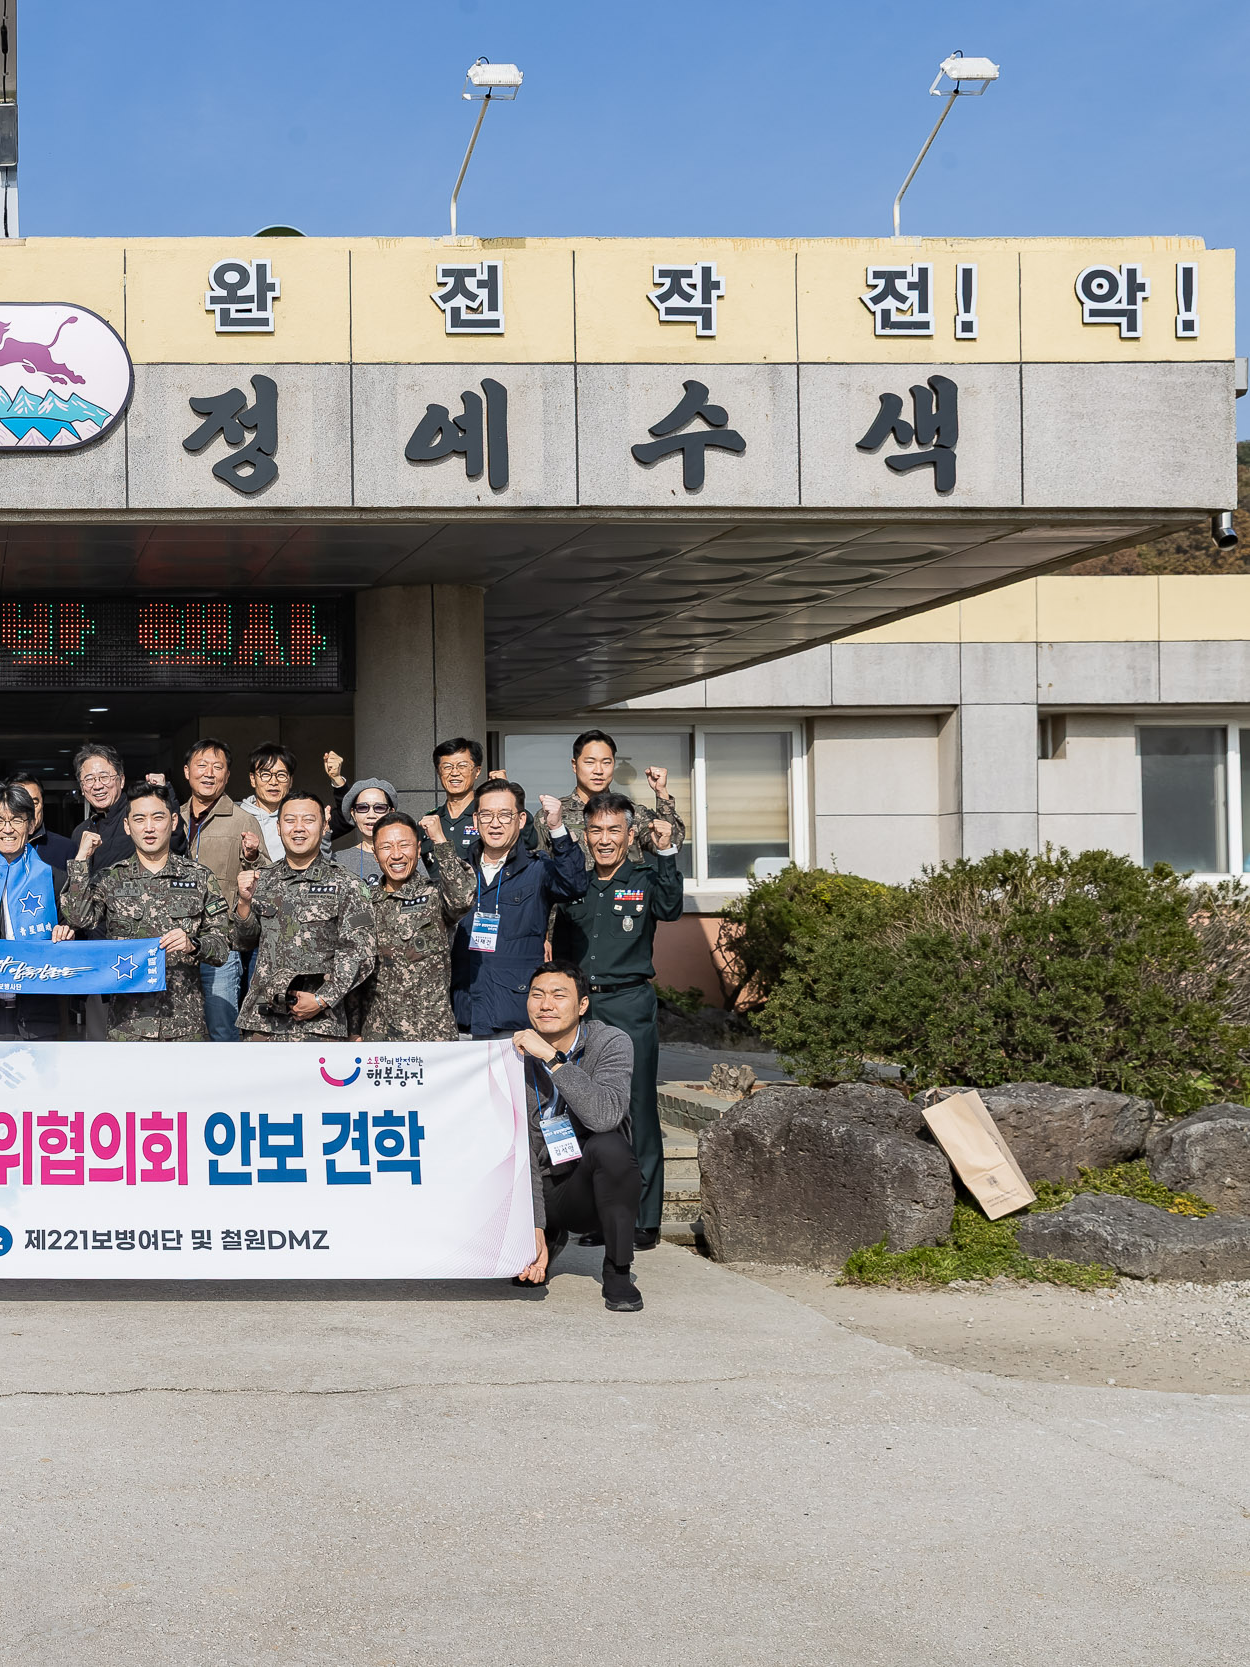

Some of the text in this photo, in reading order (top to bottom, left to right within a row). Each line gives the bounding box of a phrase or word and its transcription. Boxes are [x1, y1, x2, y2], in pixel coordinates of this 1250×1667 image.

[182, 373, 960, 493] 정예수색
[395, 1056, 423, 1068] 발전하는
[366, 1067, 423, 1087] 행복광진
[204, 1111, 307, 1185] 안보
[321, 1109, 425, 1186] 견학
[24, 1228, 183, 1251] 제221보병여단
[191, 1228, 214, 1251] 및
[220, 1228, 330, 1251] 철원DMZ
